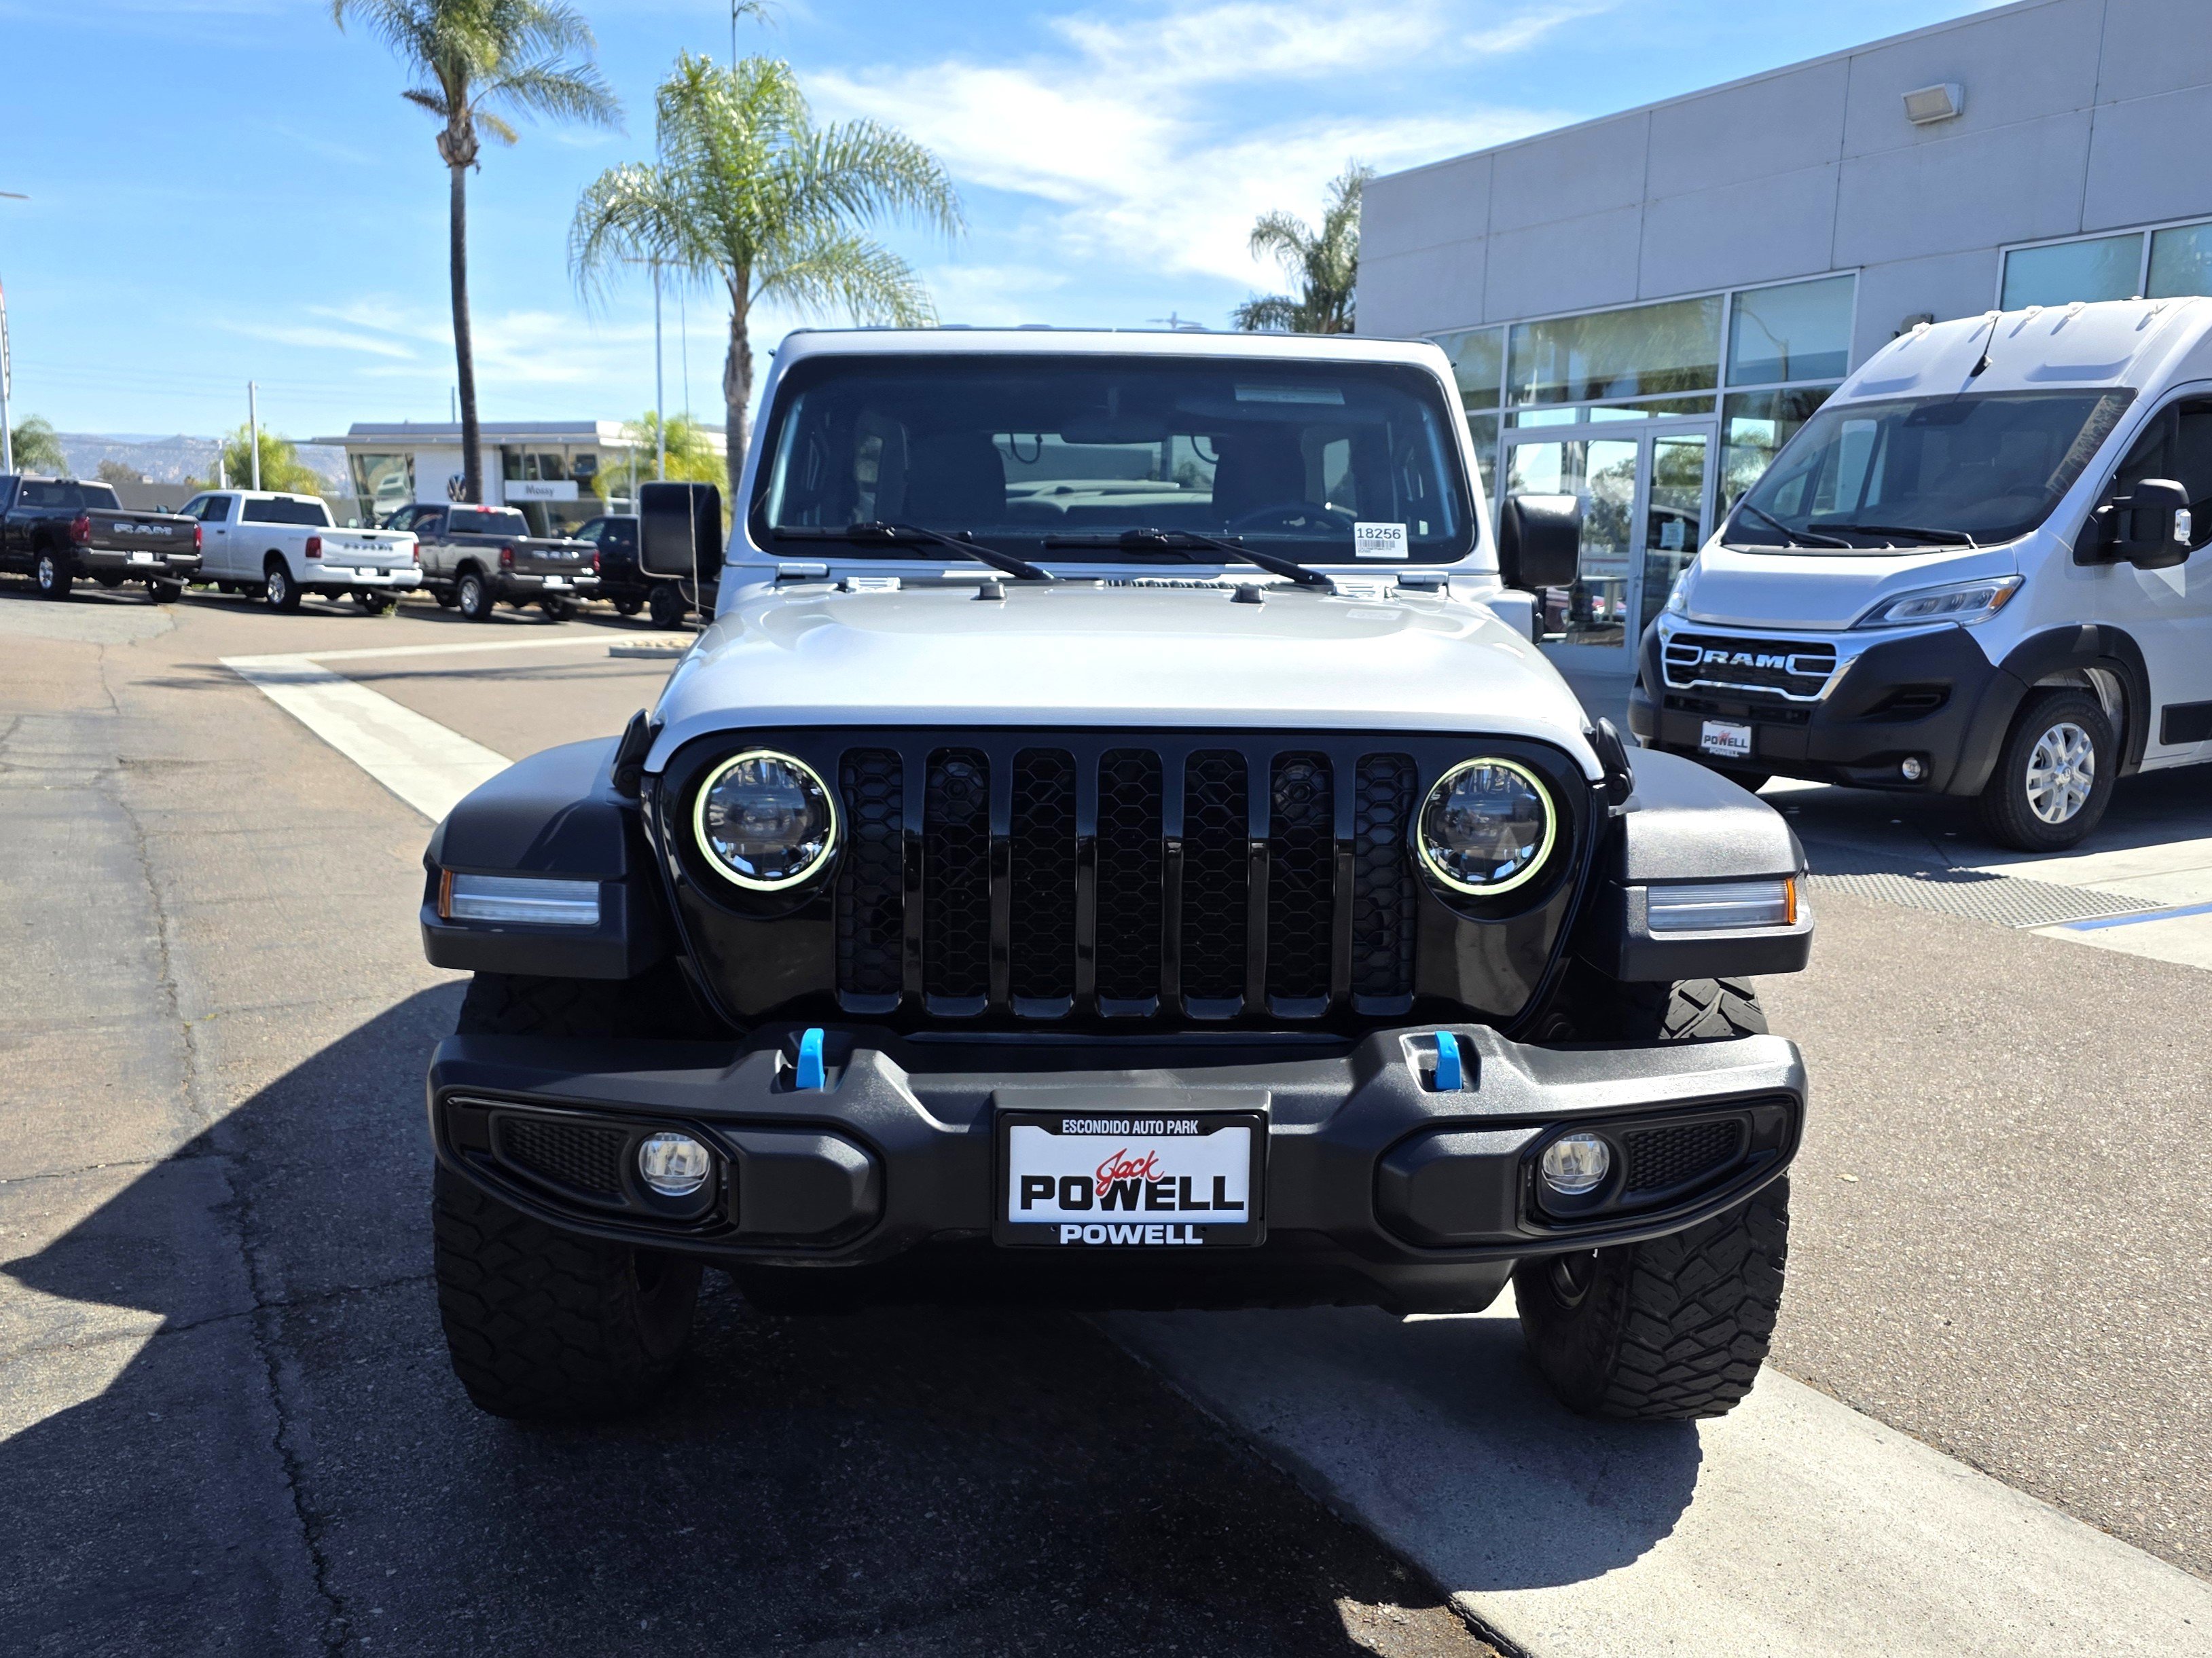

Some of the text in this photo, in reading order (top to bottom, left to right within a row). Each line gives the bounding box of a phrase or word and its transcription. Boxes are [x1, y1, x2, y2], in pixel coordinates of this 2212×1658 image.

[526, 484, 554, 497] Mossy
[113, 523, 173, 536] RAM
[1357, 528, 1401, 540] 18256
[1703, 650, 1786, 669] RAM
[1703, 735, 1748, 748] POWELL
[1062, 1119, 1199, 1135] ESCONDIDO AUTO PARK
[1095, 1147, 1165, 1197] Jack
[1020, 1175, 1244, 1211] POWELL
[1059, 1224, 1203, 1245] POWELL
